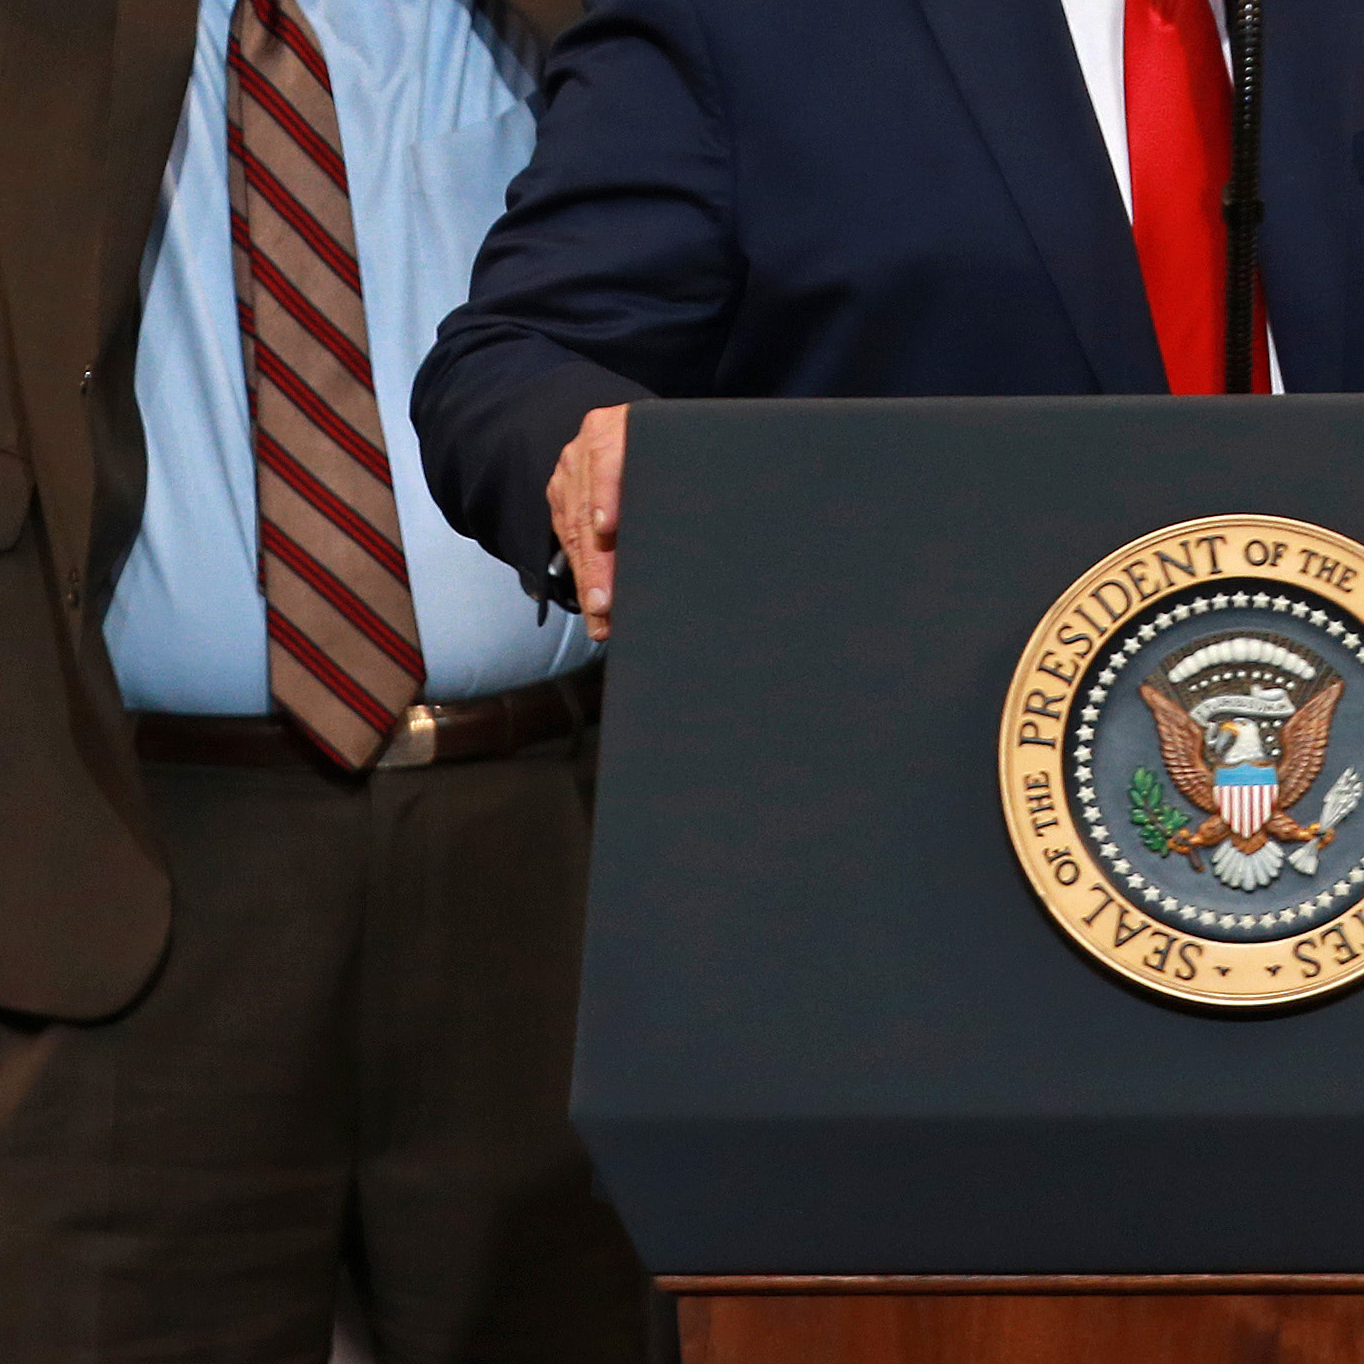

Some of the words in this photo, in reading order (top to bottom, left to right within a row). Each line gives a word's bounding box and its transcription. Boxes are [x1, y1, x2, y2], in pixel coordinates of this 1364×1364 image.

[1243, 539, 1288, 567] OF
[1299, 549, 1358, 593] THE
[1018, 534, 1229, 750] PRESIDENT
[1023, 769, 1060, 838] THE
[1043, 845, 1080, 886] OF
[1082, 882, 1203, 981] SEAL
